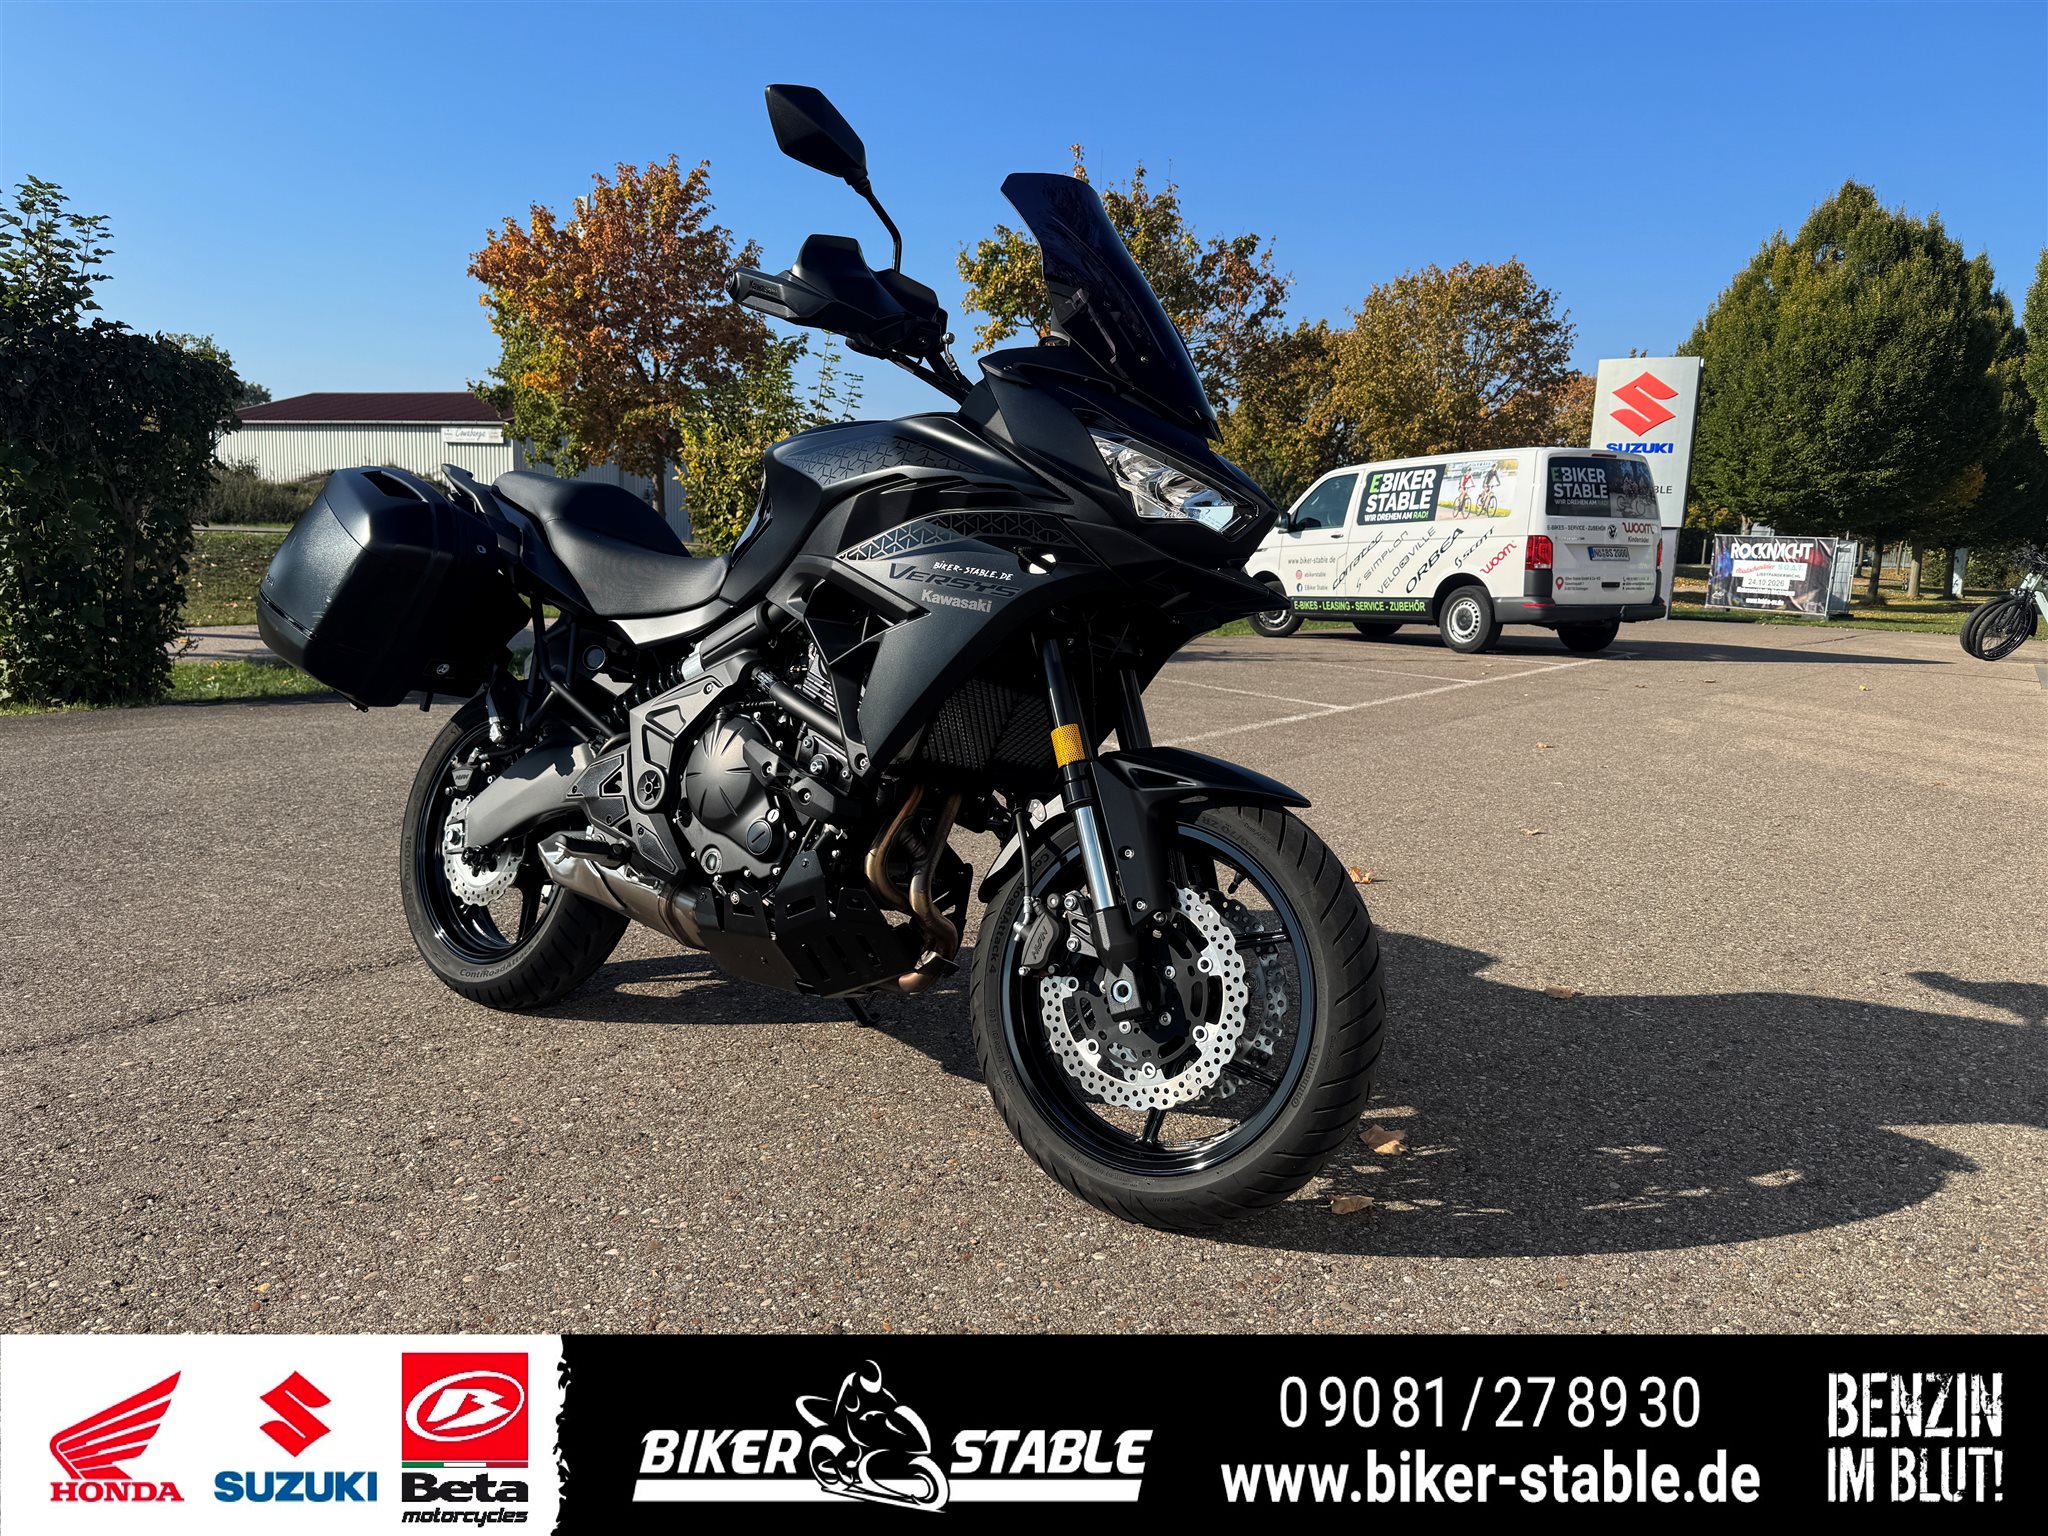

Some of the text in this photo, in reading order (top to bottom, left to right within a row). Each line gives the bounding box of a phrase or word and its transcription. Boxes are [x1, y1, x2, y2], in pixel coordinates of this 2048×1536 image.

[1606, 443, 1674, 454] SUZUKI
[1369, 469, 1437, 493] EBIKER
[1550, 467, 1607, 483] EBIKER
[1365, 489, 1433, 513] STABLE
[1553, 483, 1608, 498] STABLE
[1364, 511, 1429, 522] WIR DREHEN AM RAD!
[1463, 525, 1495, 560] SCOTT
[1731, 543, 1814, 561] ROCKNACHT
[1406, 528, 1464, 593] ORBEA
[1480, 543, 1518, 574] woom
[889, 563, 1023, 599] VERSYS
[921, 589, 992, 613] Kawasaki
[1294, 600, 1426, 612] E-BIKES LEASING SERVICE ZUBEHÖR
